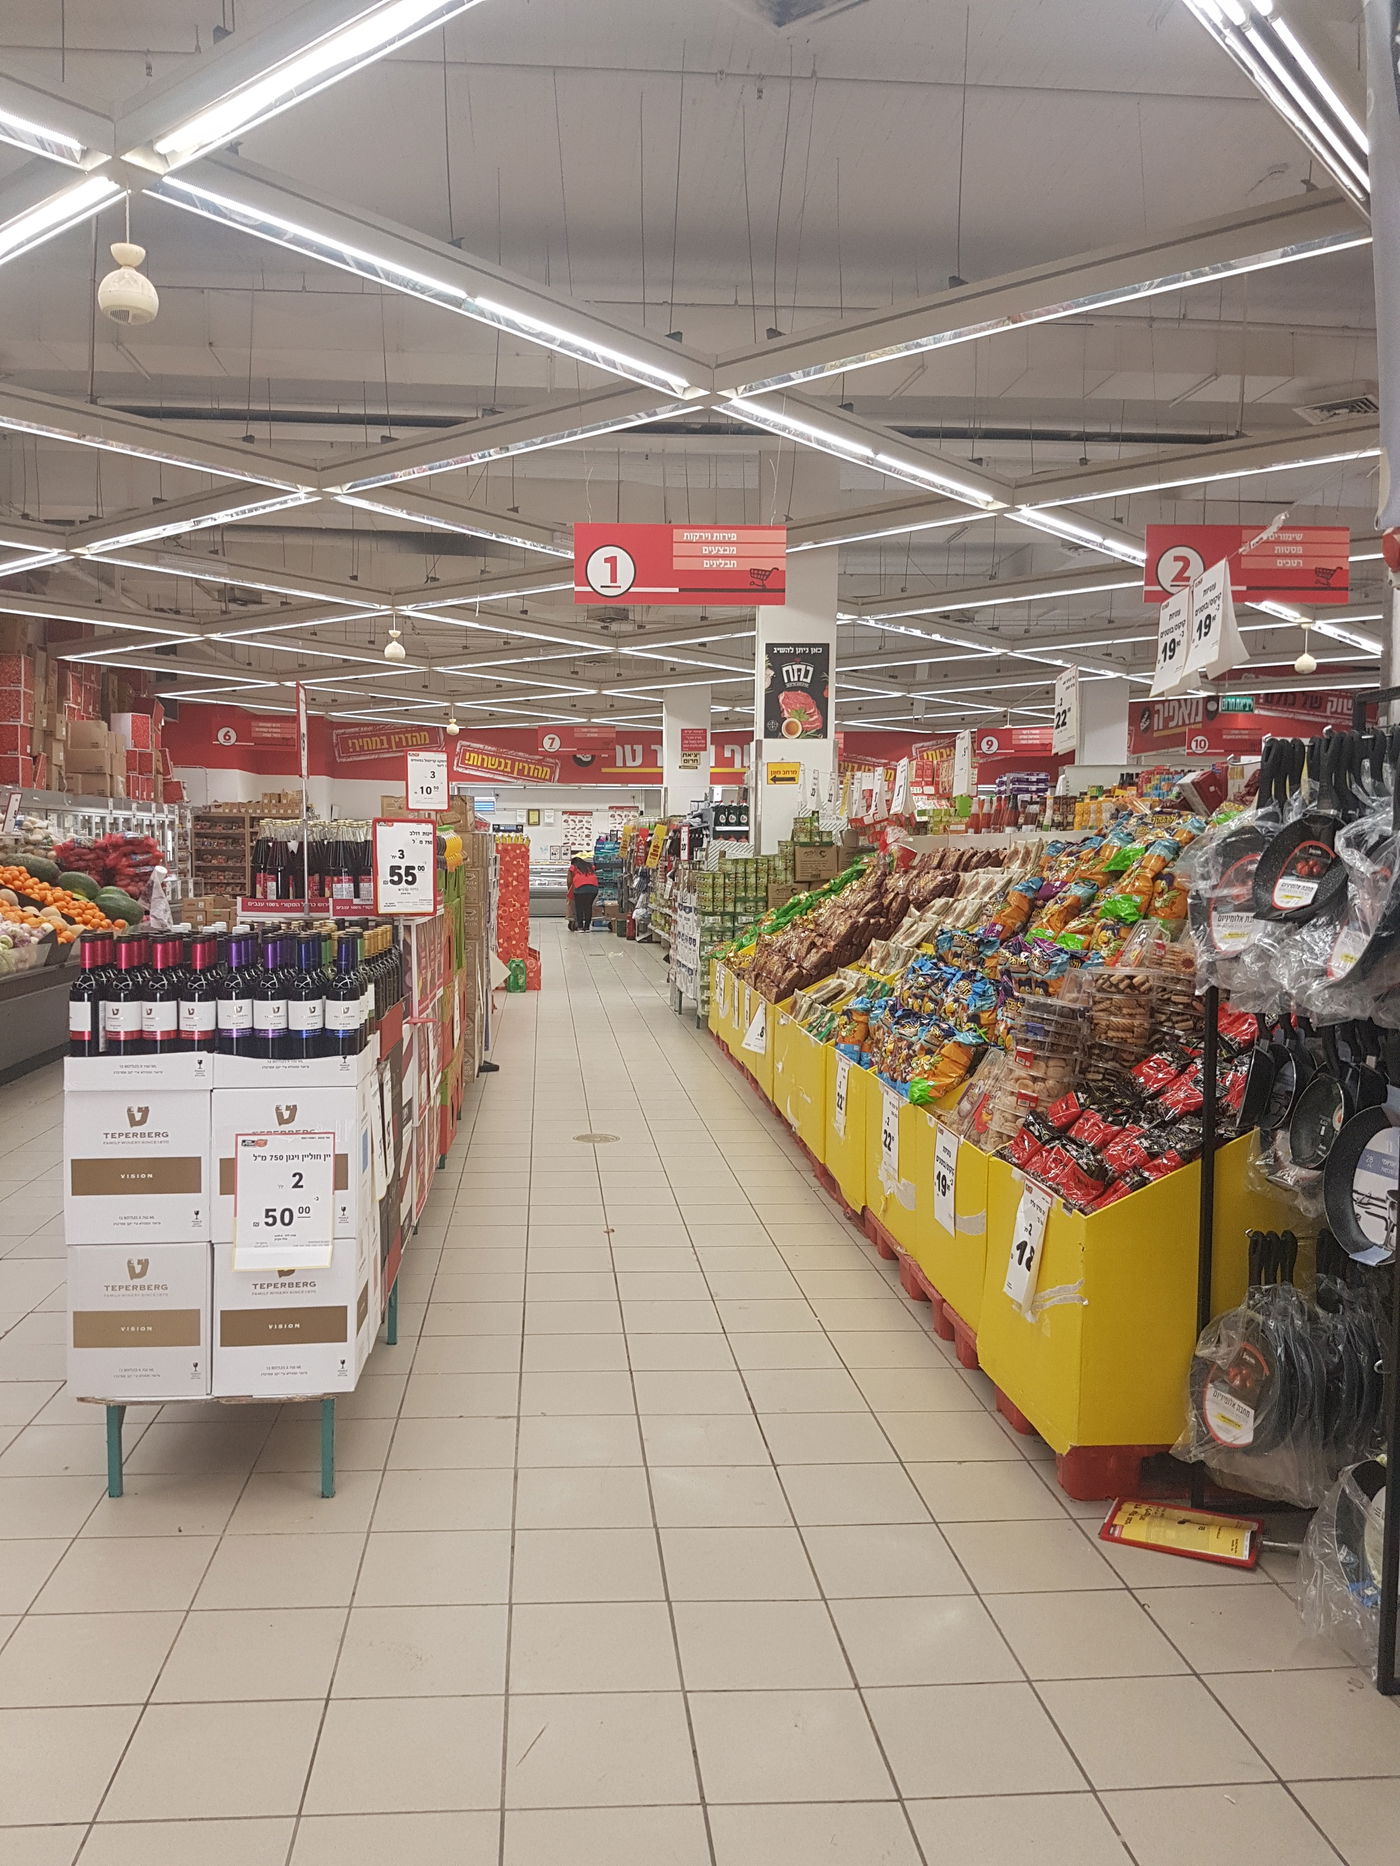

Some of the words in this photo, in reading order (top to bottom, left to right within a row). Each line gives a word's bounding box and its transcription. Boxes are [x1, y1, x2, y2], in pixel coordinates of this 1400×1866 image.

[683, 532, 711, 542] וירקות
[712, 532, 737, 541] פירות
[702, 546, 737, 555] מבצעים
[703, 558, 737, 568] תבלינים
[1169, 555, 1192, 583] 2
[603, 555, 619, 584] 1
[1196, 613, 1212, 641] 19
[1161, 637, 1176, 663] 19
[782, 664, 814, 684] נתח
[1054, 709, 1067, 730] 22
[222, 730, 232, 742] 6
[391, 731, 430, 752] מהדרין
[547, 737, 556, 747] 7
[348, 735, 389, 752] במחיר!
[986, 739, 994, 750] 9
[1193, 739, 1207, 749] 10
[430, 770, 436, 779] 3
[513, 761, 551, 780] מהדרין
[420, 785, 433, 795] 10
[397, 849, 405, 860] 3
[388, 864, 417, 886] 55
[103, 1131, 169, 1139] TEPERBERG
[883, 1128, 892, 1152] 22
[252, 1153, 267, 1162] מ"ל
[291, 1172, 304, 1189] 2
[936, 1170, 947, 1197] 19
[263, 1207, 294, 1227] 50
[298, 1206, 311, 1215] 00
[1028, 1223, 1033, 1236] 2
[103, 1283, 169, 1292] TEPERBERG
[251, 1281, 317, 1290] TEPERBERG
